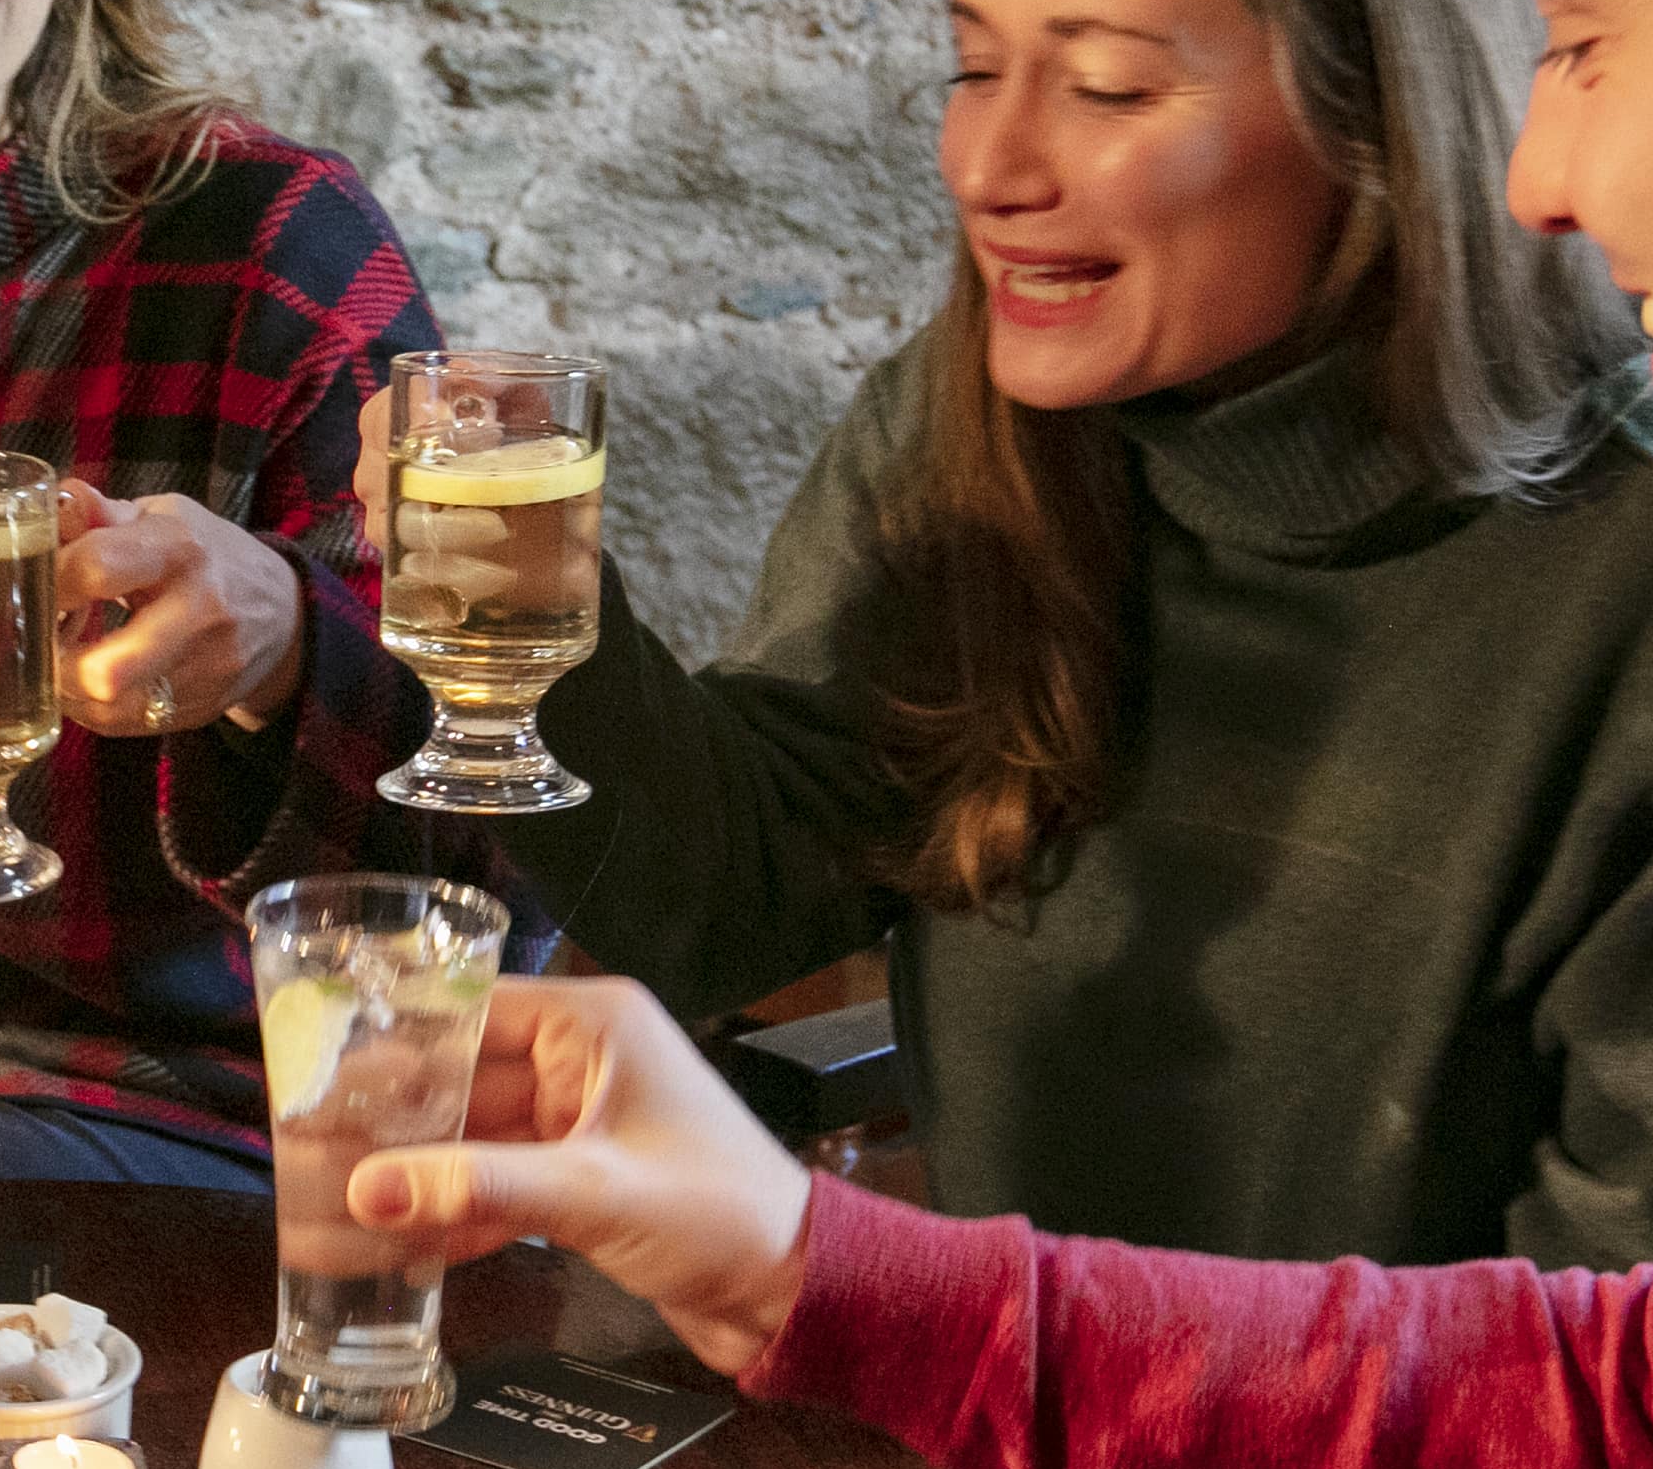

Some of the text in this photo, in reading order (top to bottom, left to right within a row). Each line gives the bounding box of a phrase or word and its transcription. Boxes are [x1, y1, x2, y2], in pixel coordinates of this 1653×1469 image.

[471, 1398, 530, 1423] TIME
[497, 1384, 632, 1430] GUINNESS
[531, 1416, 607, 1444] GOOD
